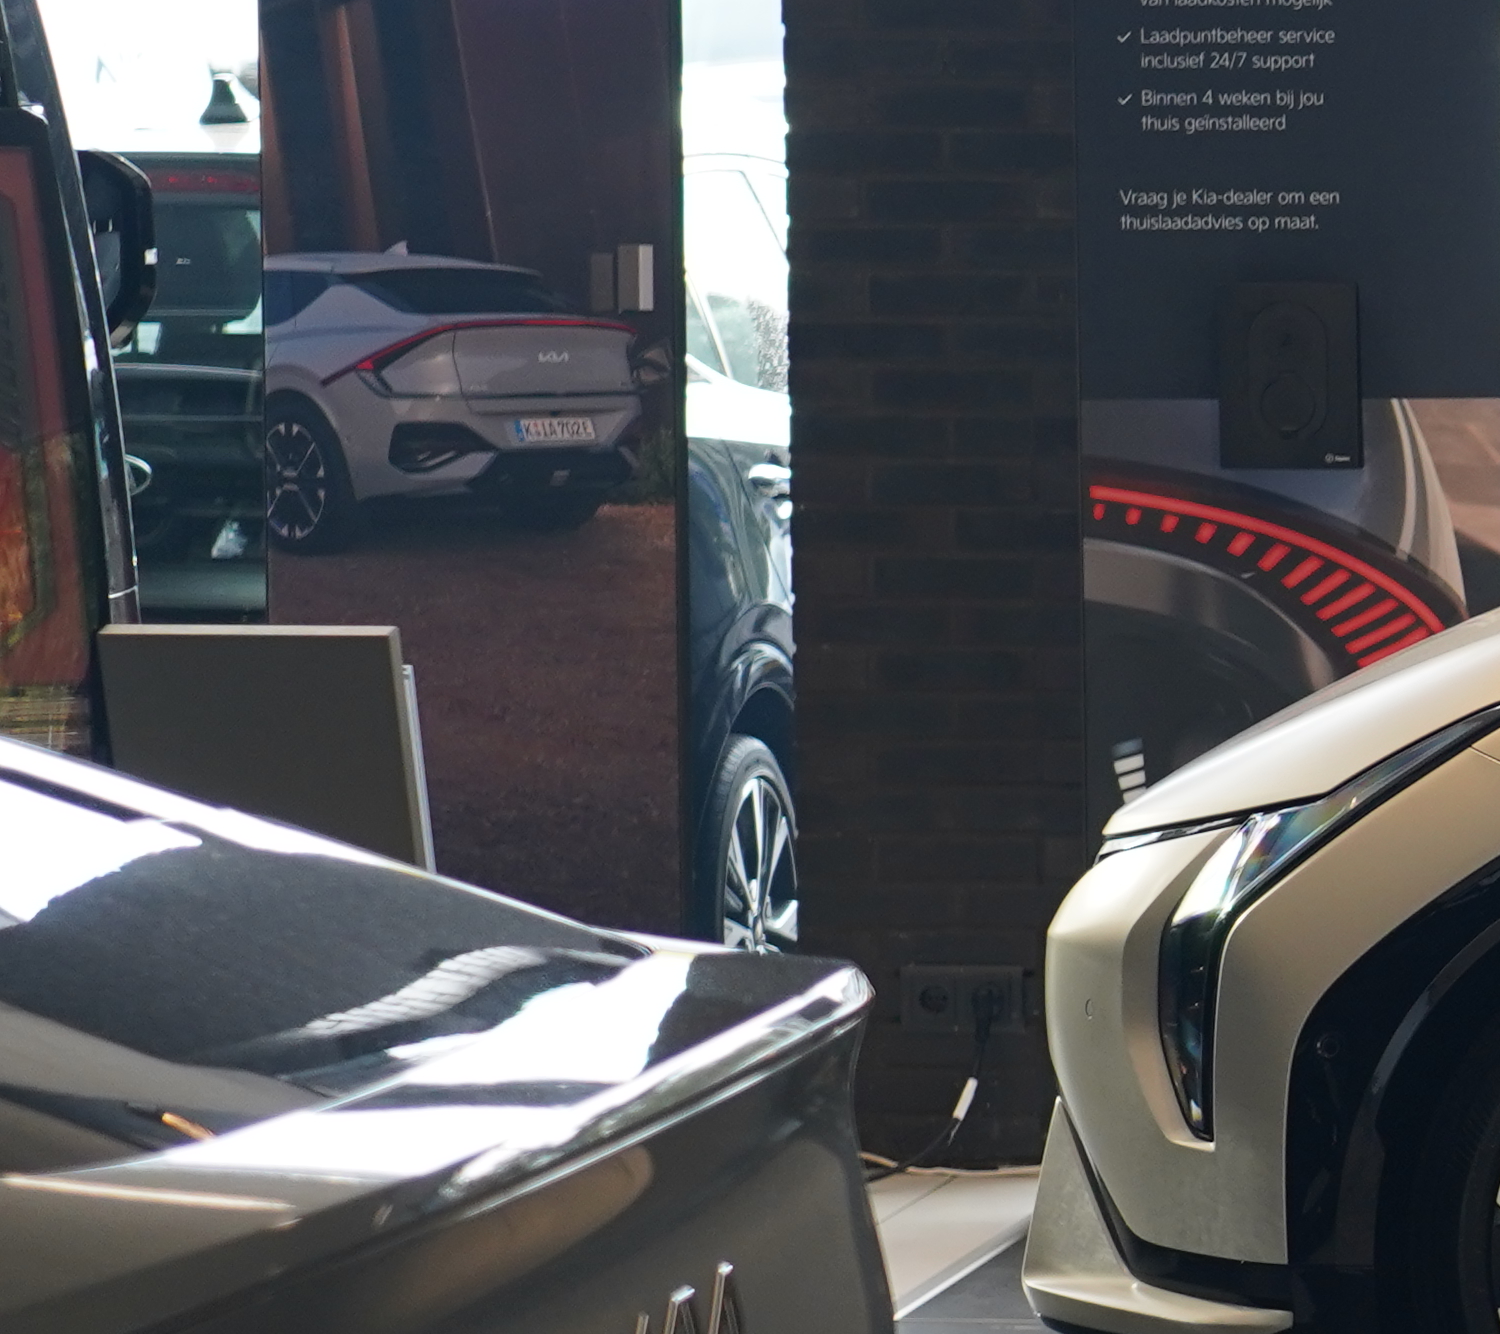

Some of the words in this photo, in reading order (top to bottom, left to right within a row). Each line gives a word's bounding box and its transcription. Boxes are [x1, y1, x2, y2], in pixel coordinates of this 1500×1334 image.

[1141, 28, 1273, 46] Laadpuntbeheer
[1279, 29, 1335, 43] service
[1141, 52, 1204, 68] inclusief
[1210, 52, 1246, 69] 24/7
[1252, 53, 1314, 71] support
[1142, 90, 1197, 106] Binnen
[1202, 90, 1212, 104] 4
[1219, 90, 1270, 105] weken
[1277, 90, 1294, 109] bij
[1298, 91, 1323, 109] jou
[1142, 115, 1179, 131] thuis
[1185, 114, 1285, 134] geïnstalleerd
[1120, 190, 1167, 209] Vraag
[1172, 191, 1186, 209] je
[1193, 189, 1273, 205] Kia-dealer
[1278, 192, 1304, 205] om
[1310, 192, 1339, 205] een
[1121, 214, 1243, 230] thuislaadadvies
[1248, 217, 1269, 232] op
[1275, 215, 1318, 229] maat.
